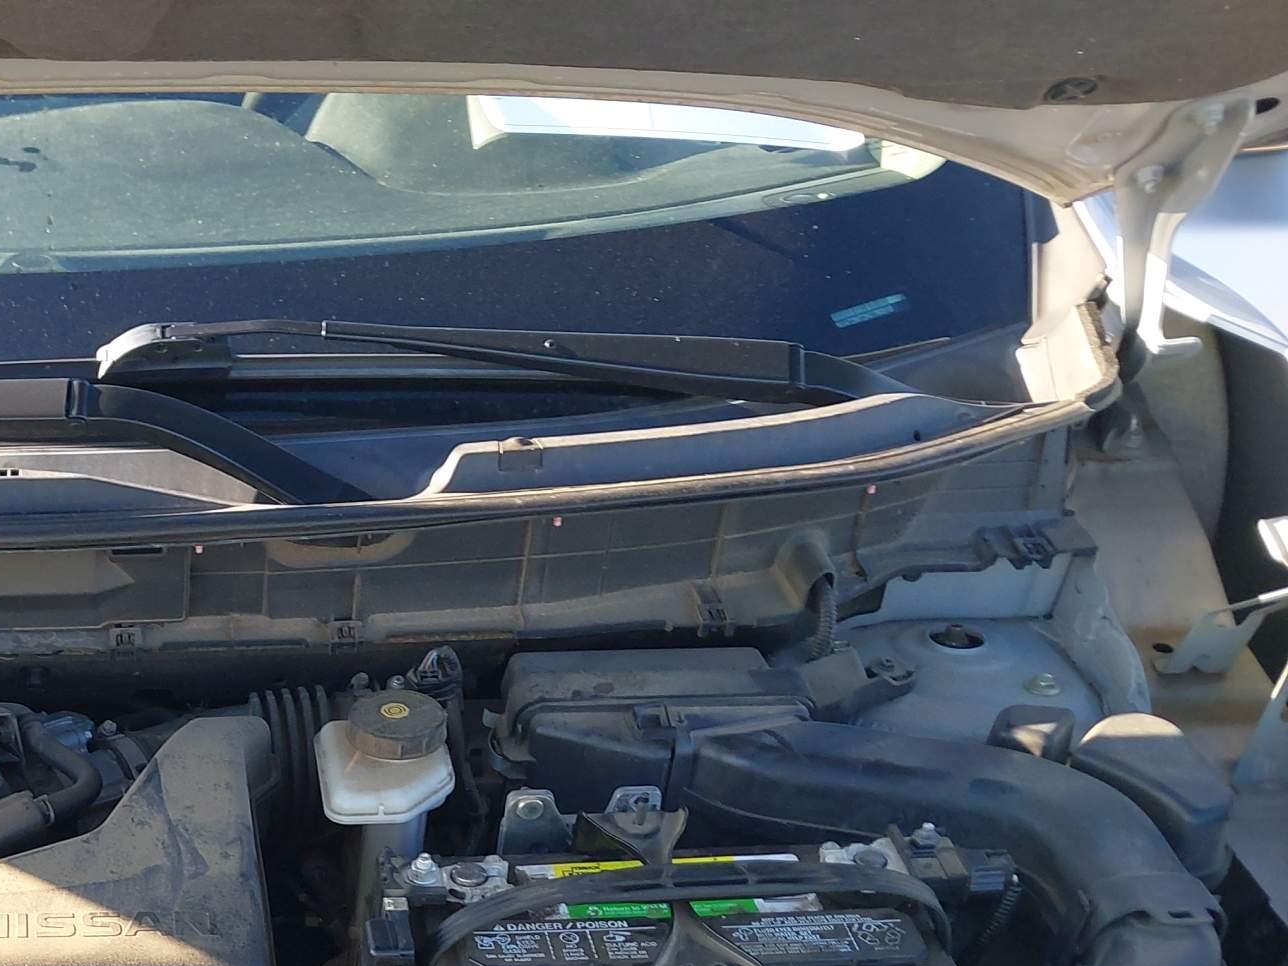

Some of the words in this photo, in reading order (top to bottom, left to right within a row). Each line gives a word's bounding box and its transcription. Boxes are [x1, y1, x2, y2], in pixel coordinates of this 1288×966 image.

[507, 922, 562, 931] DANGER
[565, 921, 574, 930] /
[576, 920, 629, 930] POISON
